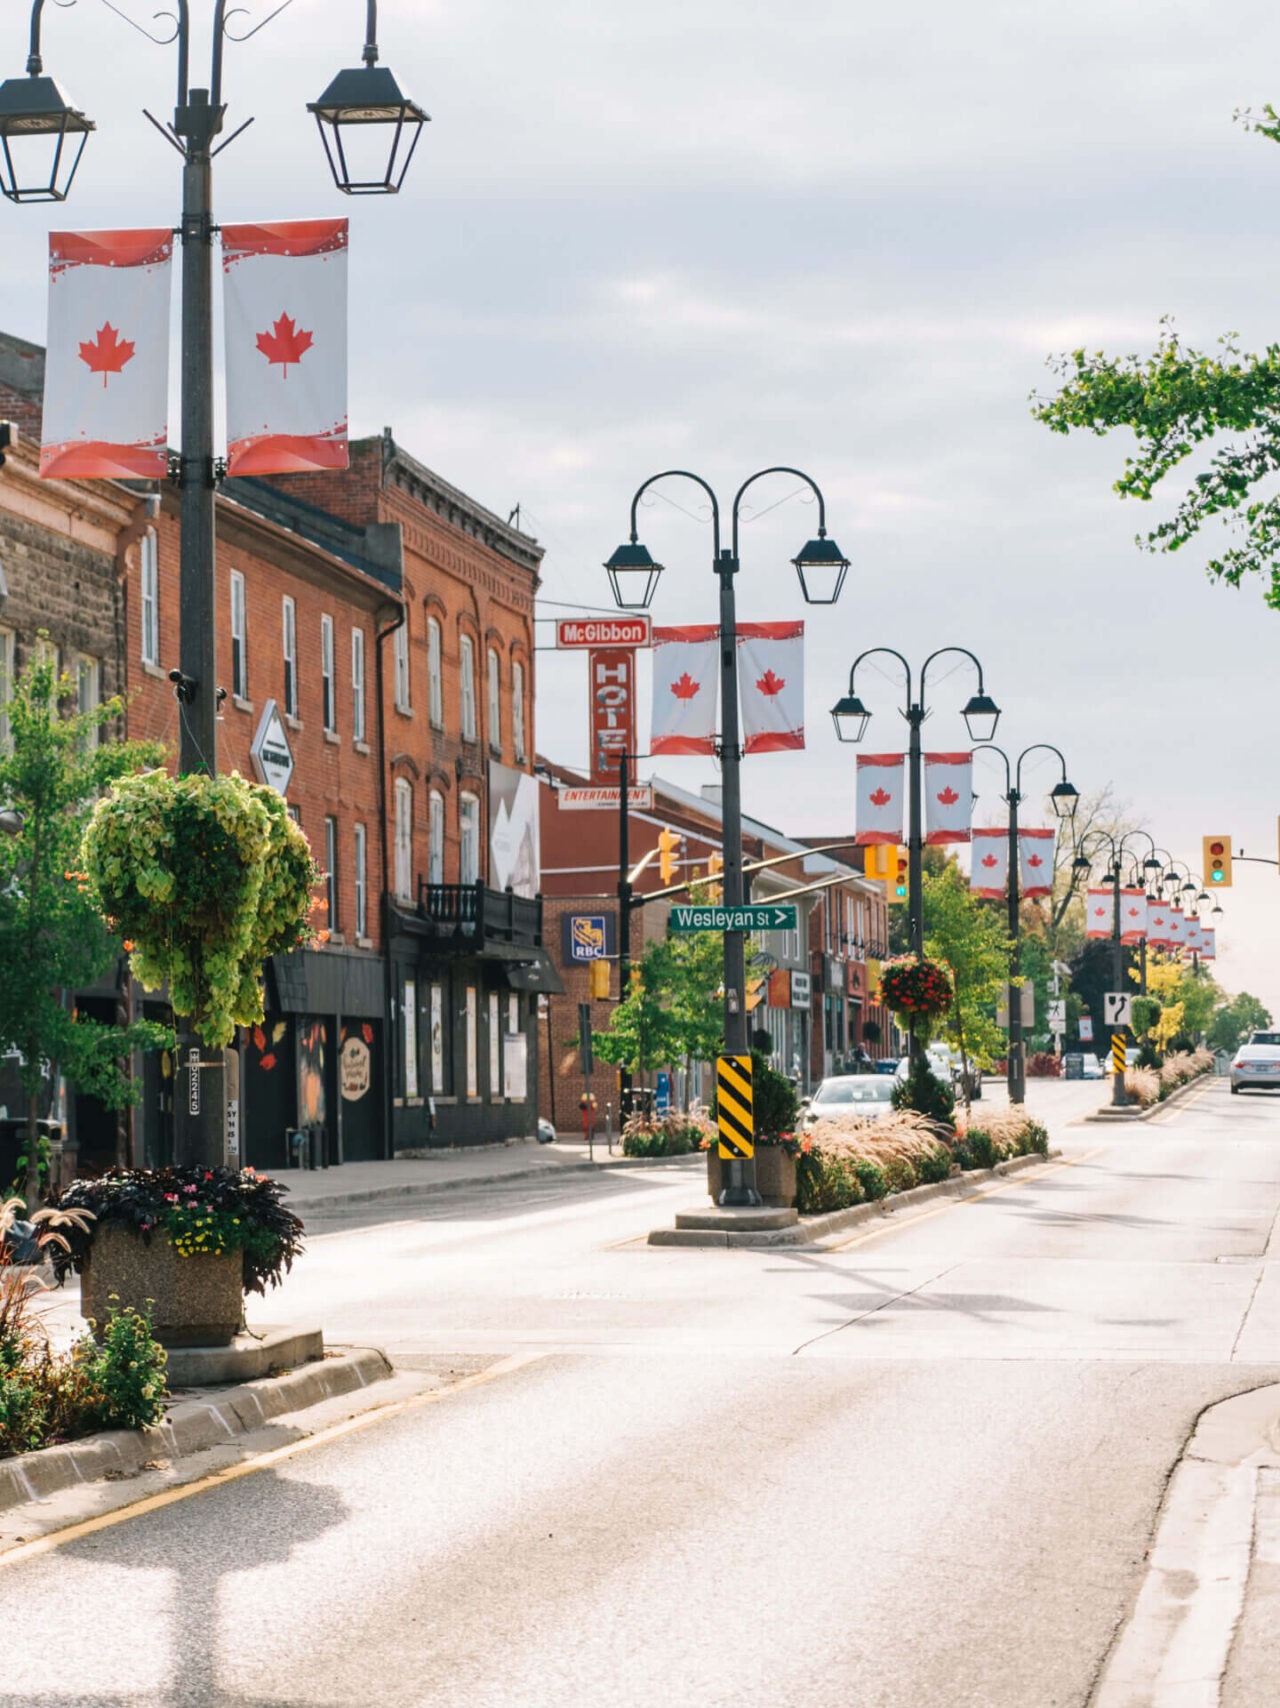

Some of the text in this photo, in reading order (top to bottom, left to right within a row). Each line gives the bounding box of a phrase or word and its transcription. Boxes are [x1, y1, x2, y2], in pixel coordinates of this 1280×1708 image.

[563, 624, 642, 642] McGibbon
[596, 663, 627, 771] HOTEL
[564, 789, 647, 802] ENTERTAINENT
[677, 909, 770, 930] Wesleyan St
[576, 945, 602, 958] RBC
